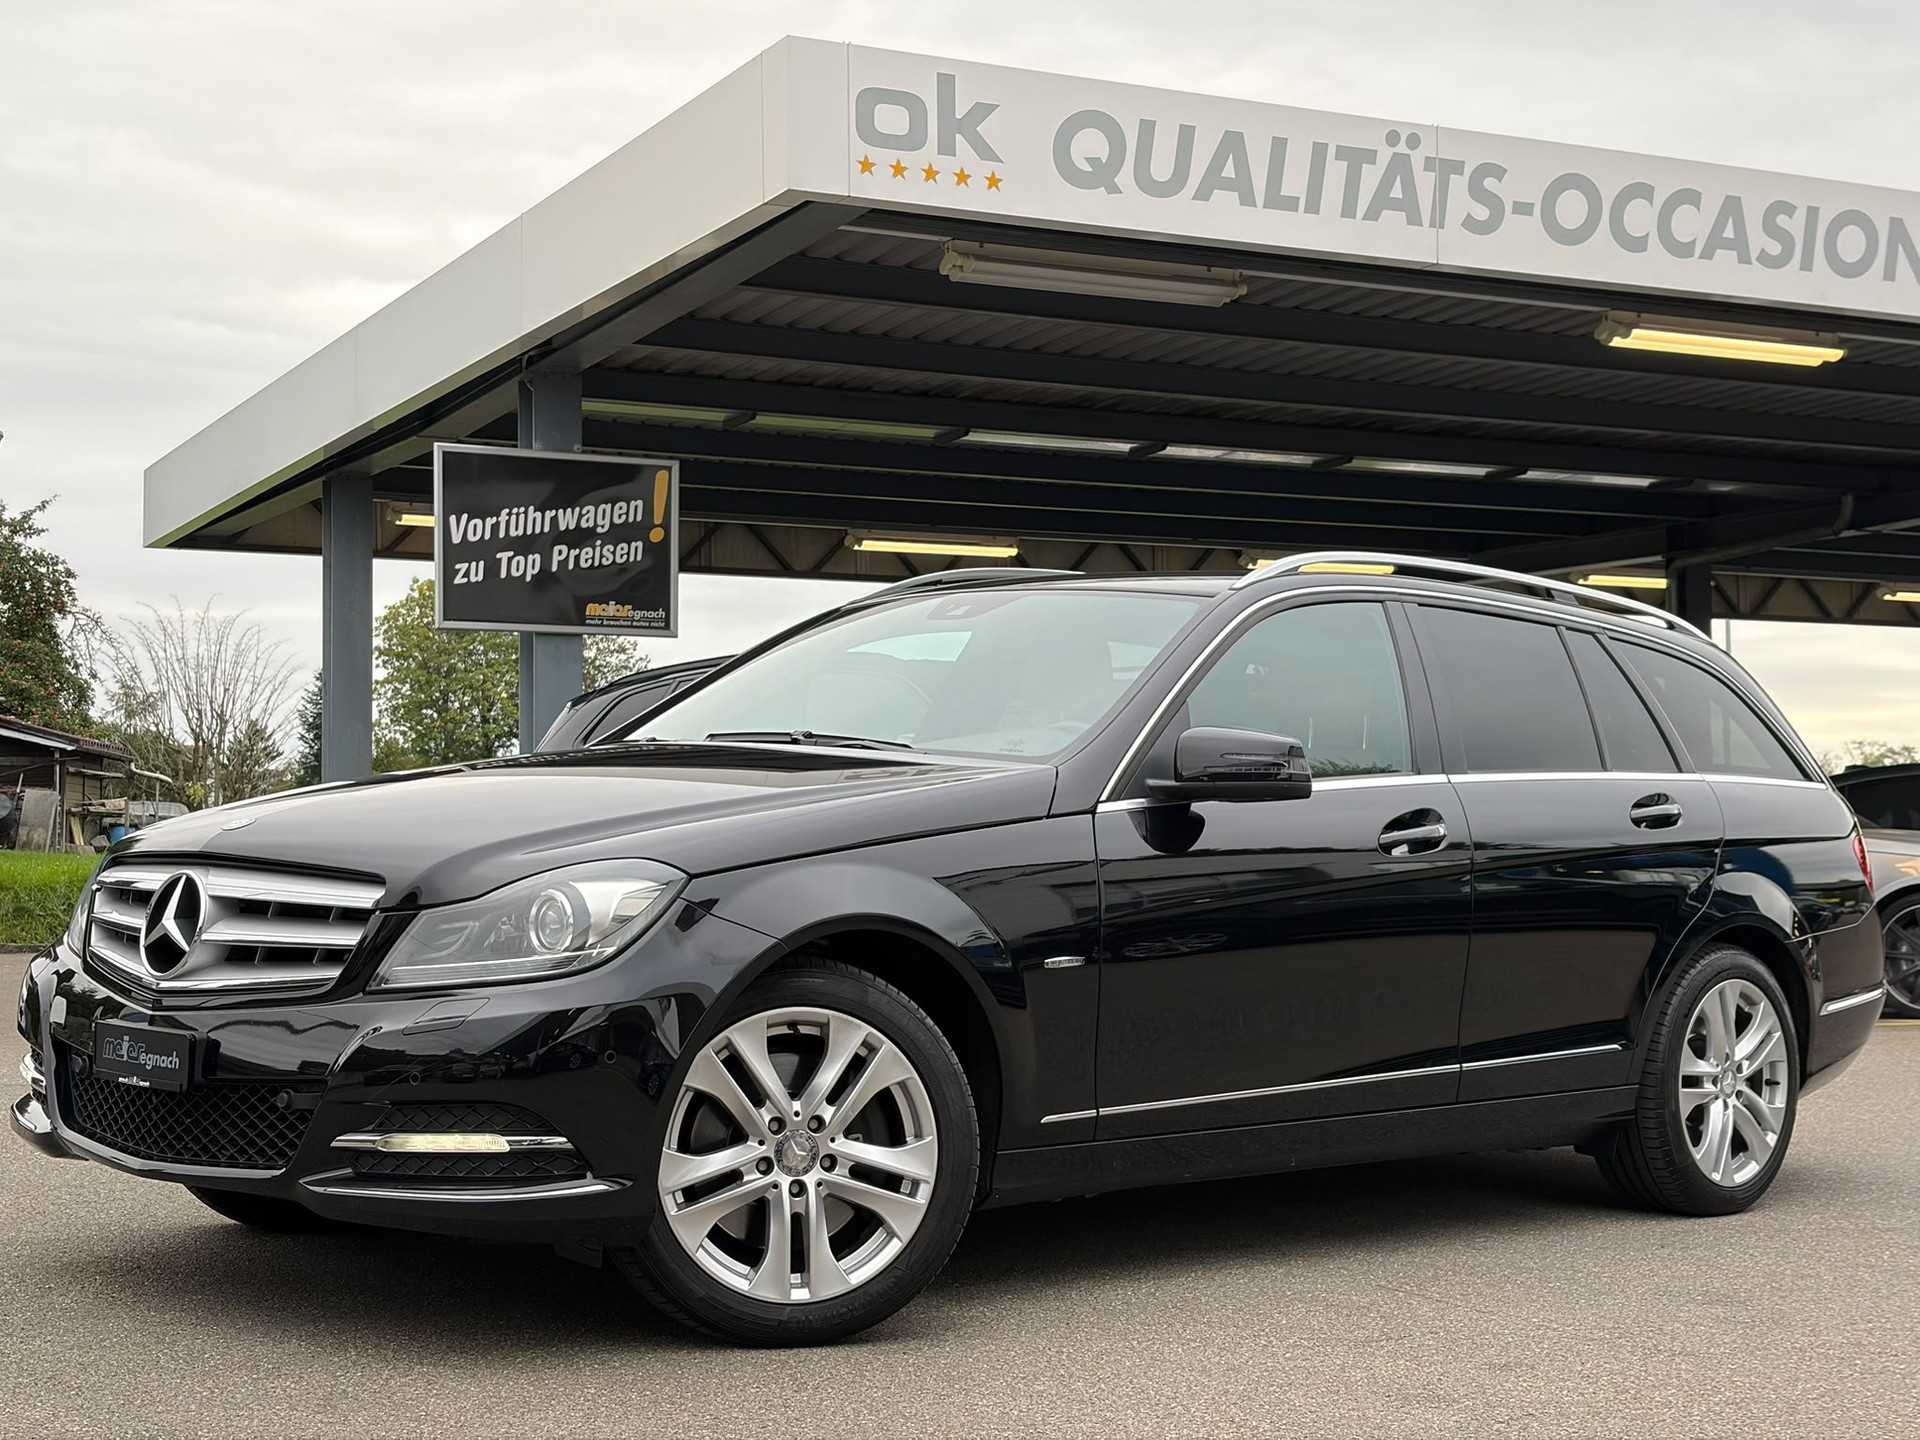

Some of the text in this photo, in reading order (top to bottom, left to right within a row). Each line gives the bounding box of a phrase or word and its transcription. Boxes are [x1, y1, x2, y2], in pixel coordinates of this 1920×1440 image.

[855, 72, 1004, 163] ok
[449, 499, 644, 545] Vorführwagen
[453, 540, 644, 585] zu Top Preisen
